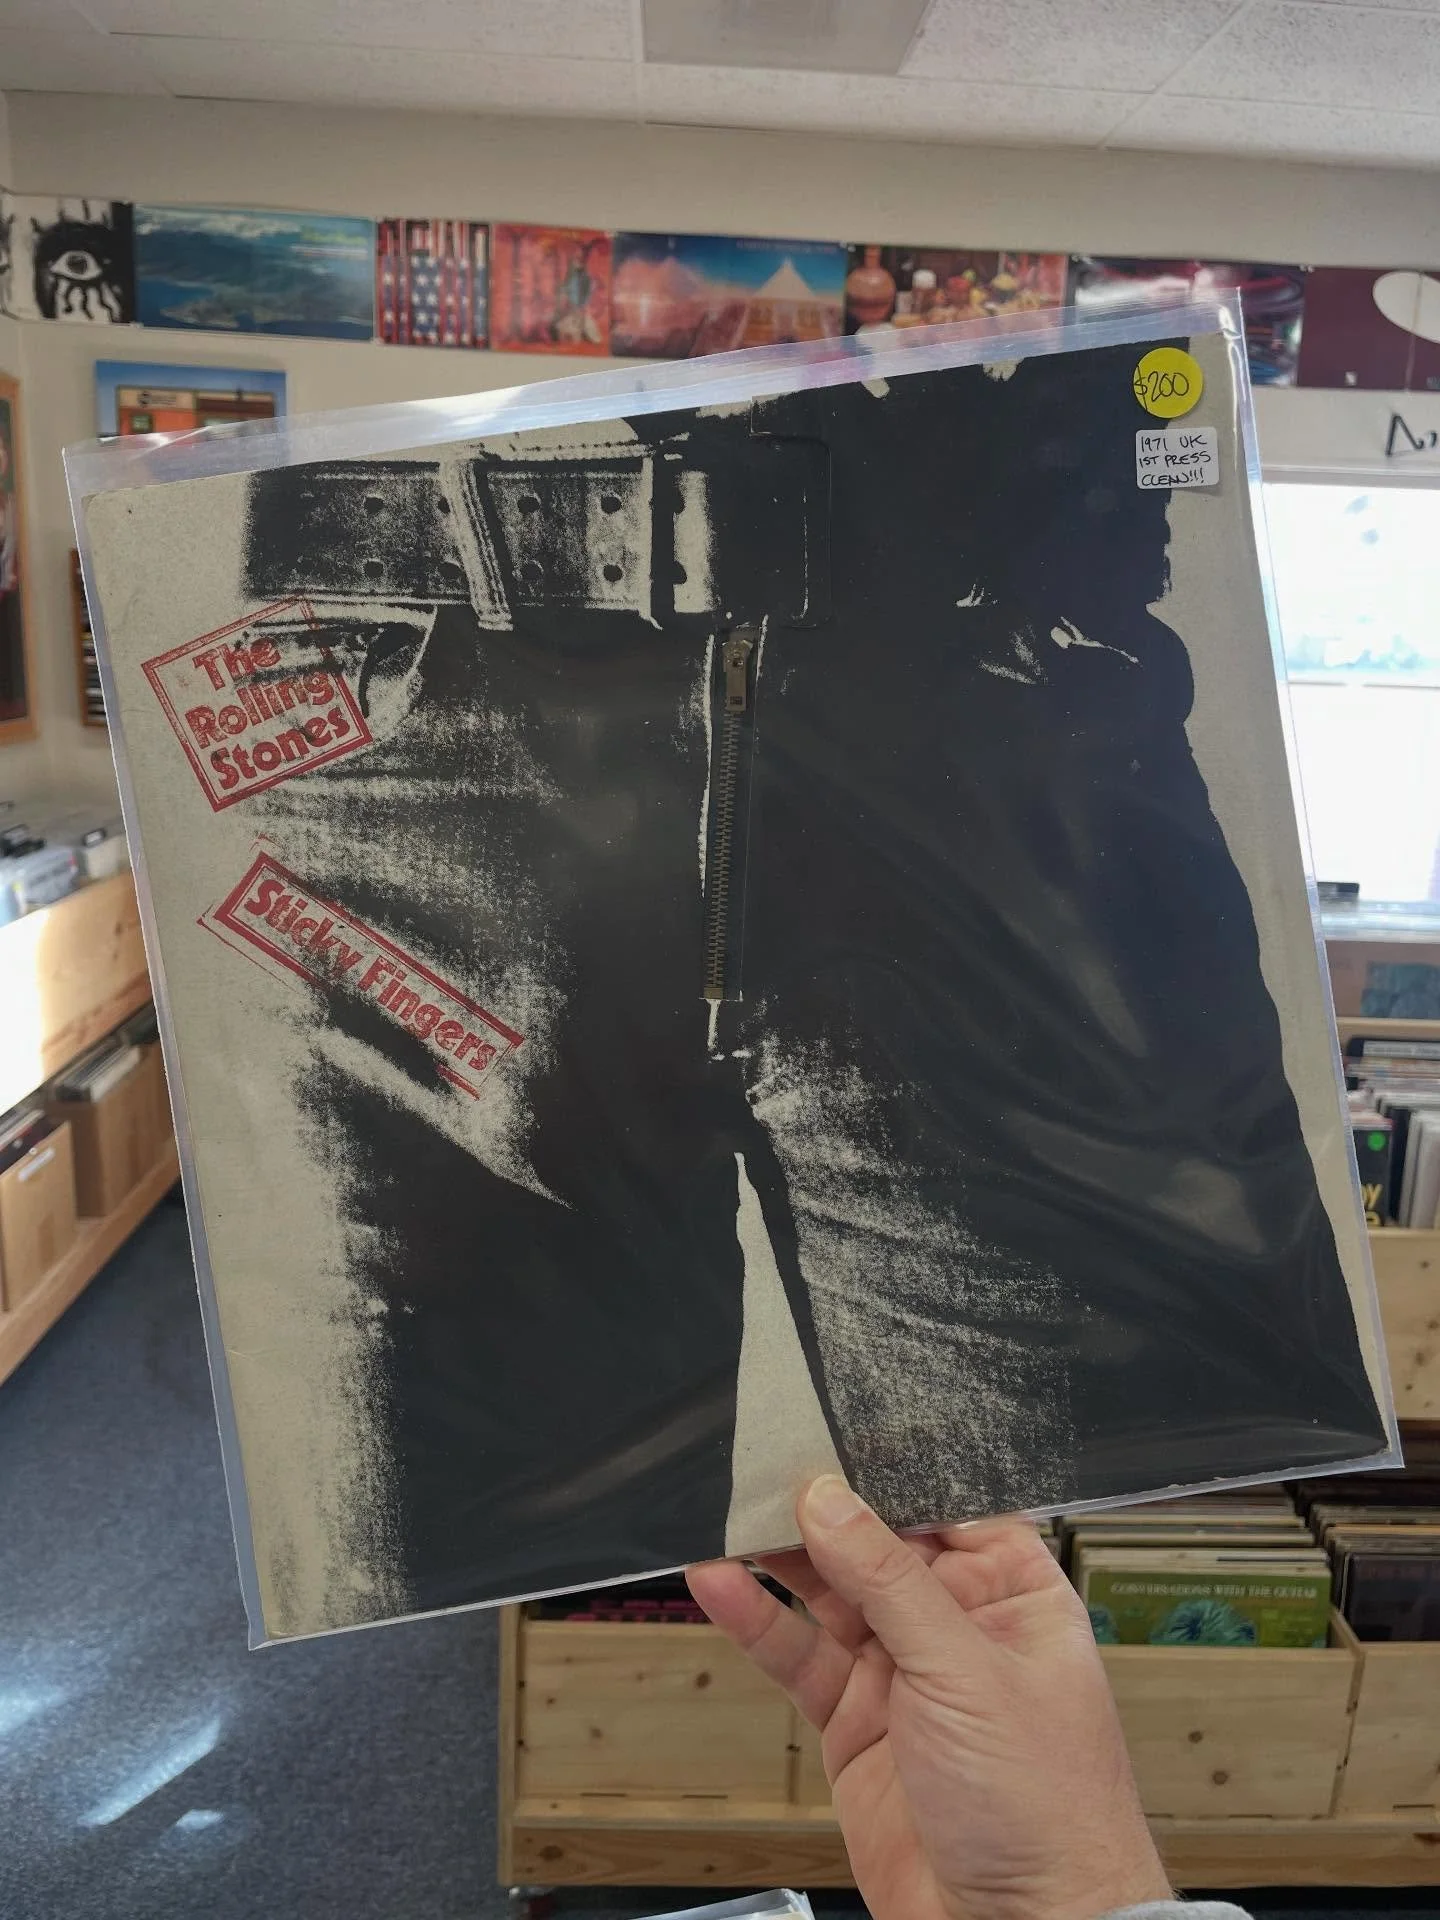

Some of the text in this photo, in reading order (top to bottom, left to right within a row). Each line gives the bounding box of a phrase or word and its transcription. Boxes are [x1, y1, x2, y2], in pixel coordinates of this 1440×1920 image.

[1133, 364, 1190, 413] $200
[1138, 451, 1211, 468] 1ST PRESS
[1140, 434, 1207, 453] 1971 UK
[1141, 468, 1204, 487] CLEAN!!!
[193, 636, 282, 691] The
[185, 670, 335, 748] Rolling
[210, 706, 351, 790] Stones
[244, 879, 497, 1072] Sticky Fingers
